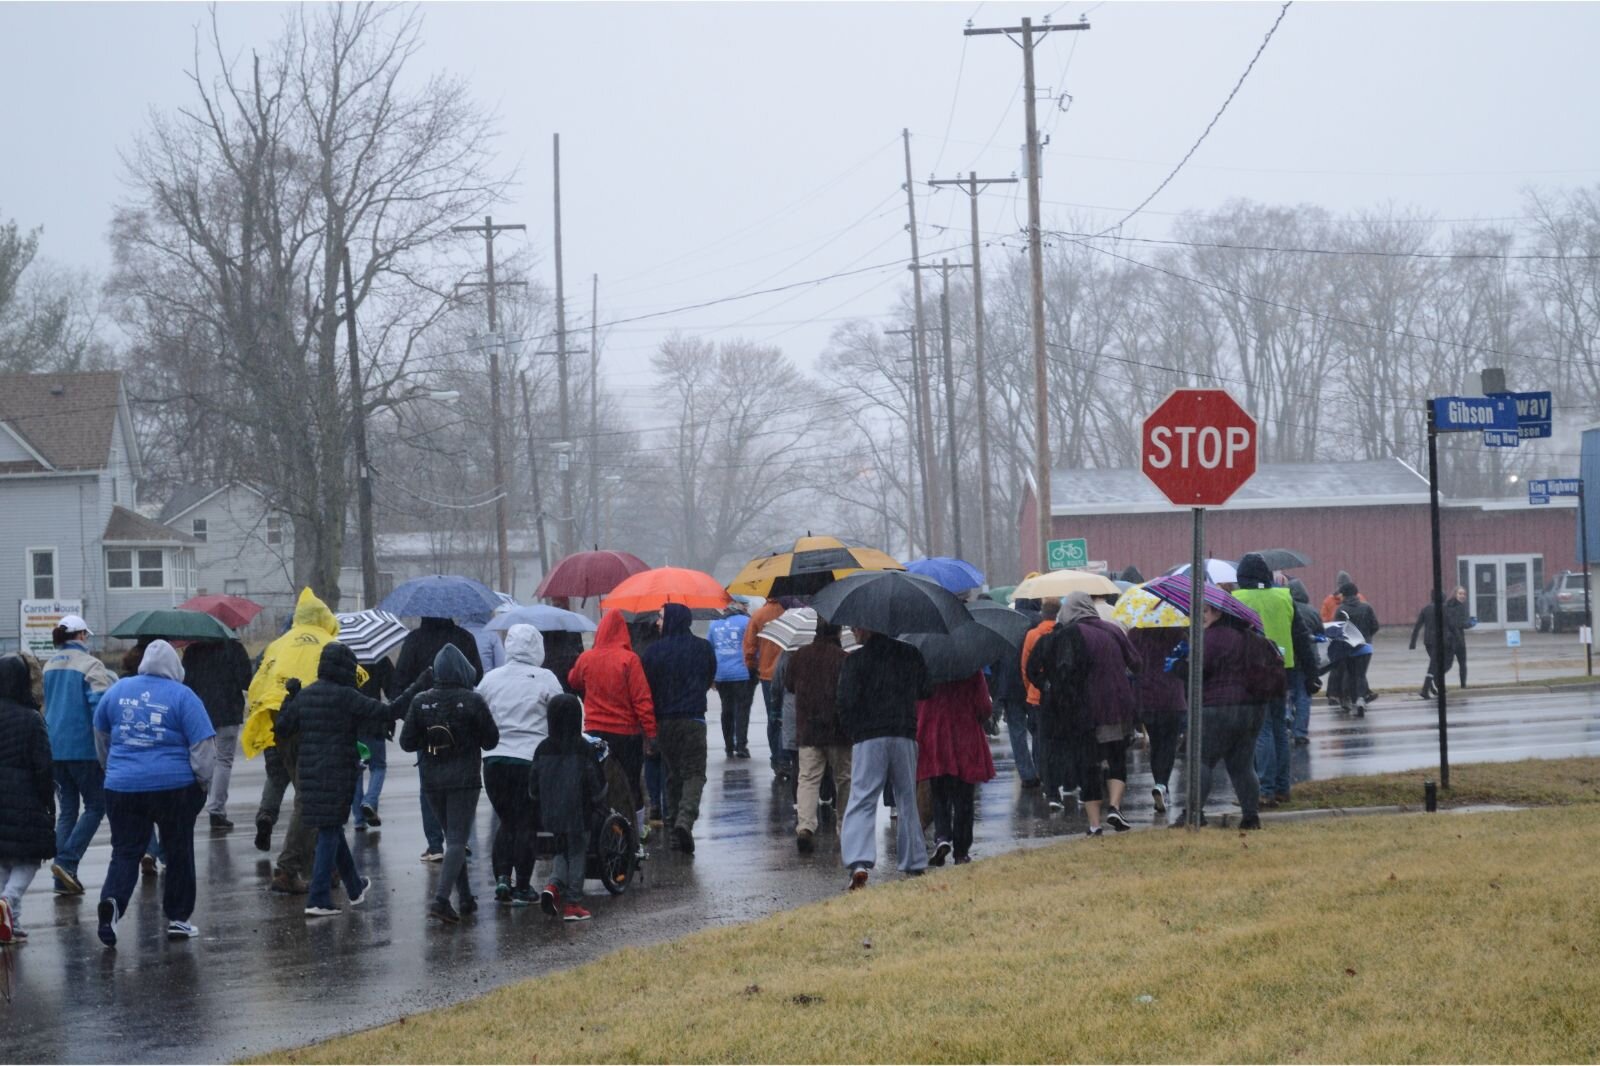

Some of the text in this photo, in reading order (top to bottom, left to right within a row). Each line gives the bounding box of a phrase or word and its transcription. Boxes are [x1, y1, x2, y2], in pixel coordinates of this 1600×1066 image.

[1448, 400, 1494, 424] Gibson
[1485, 432, 1518, 446] King Hwy
[1148, 425, 1250, 469] STOP
[1530, 480, 1579, 495] King Highway
[23, 602, 80, 614] Carpet House
